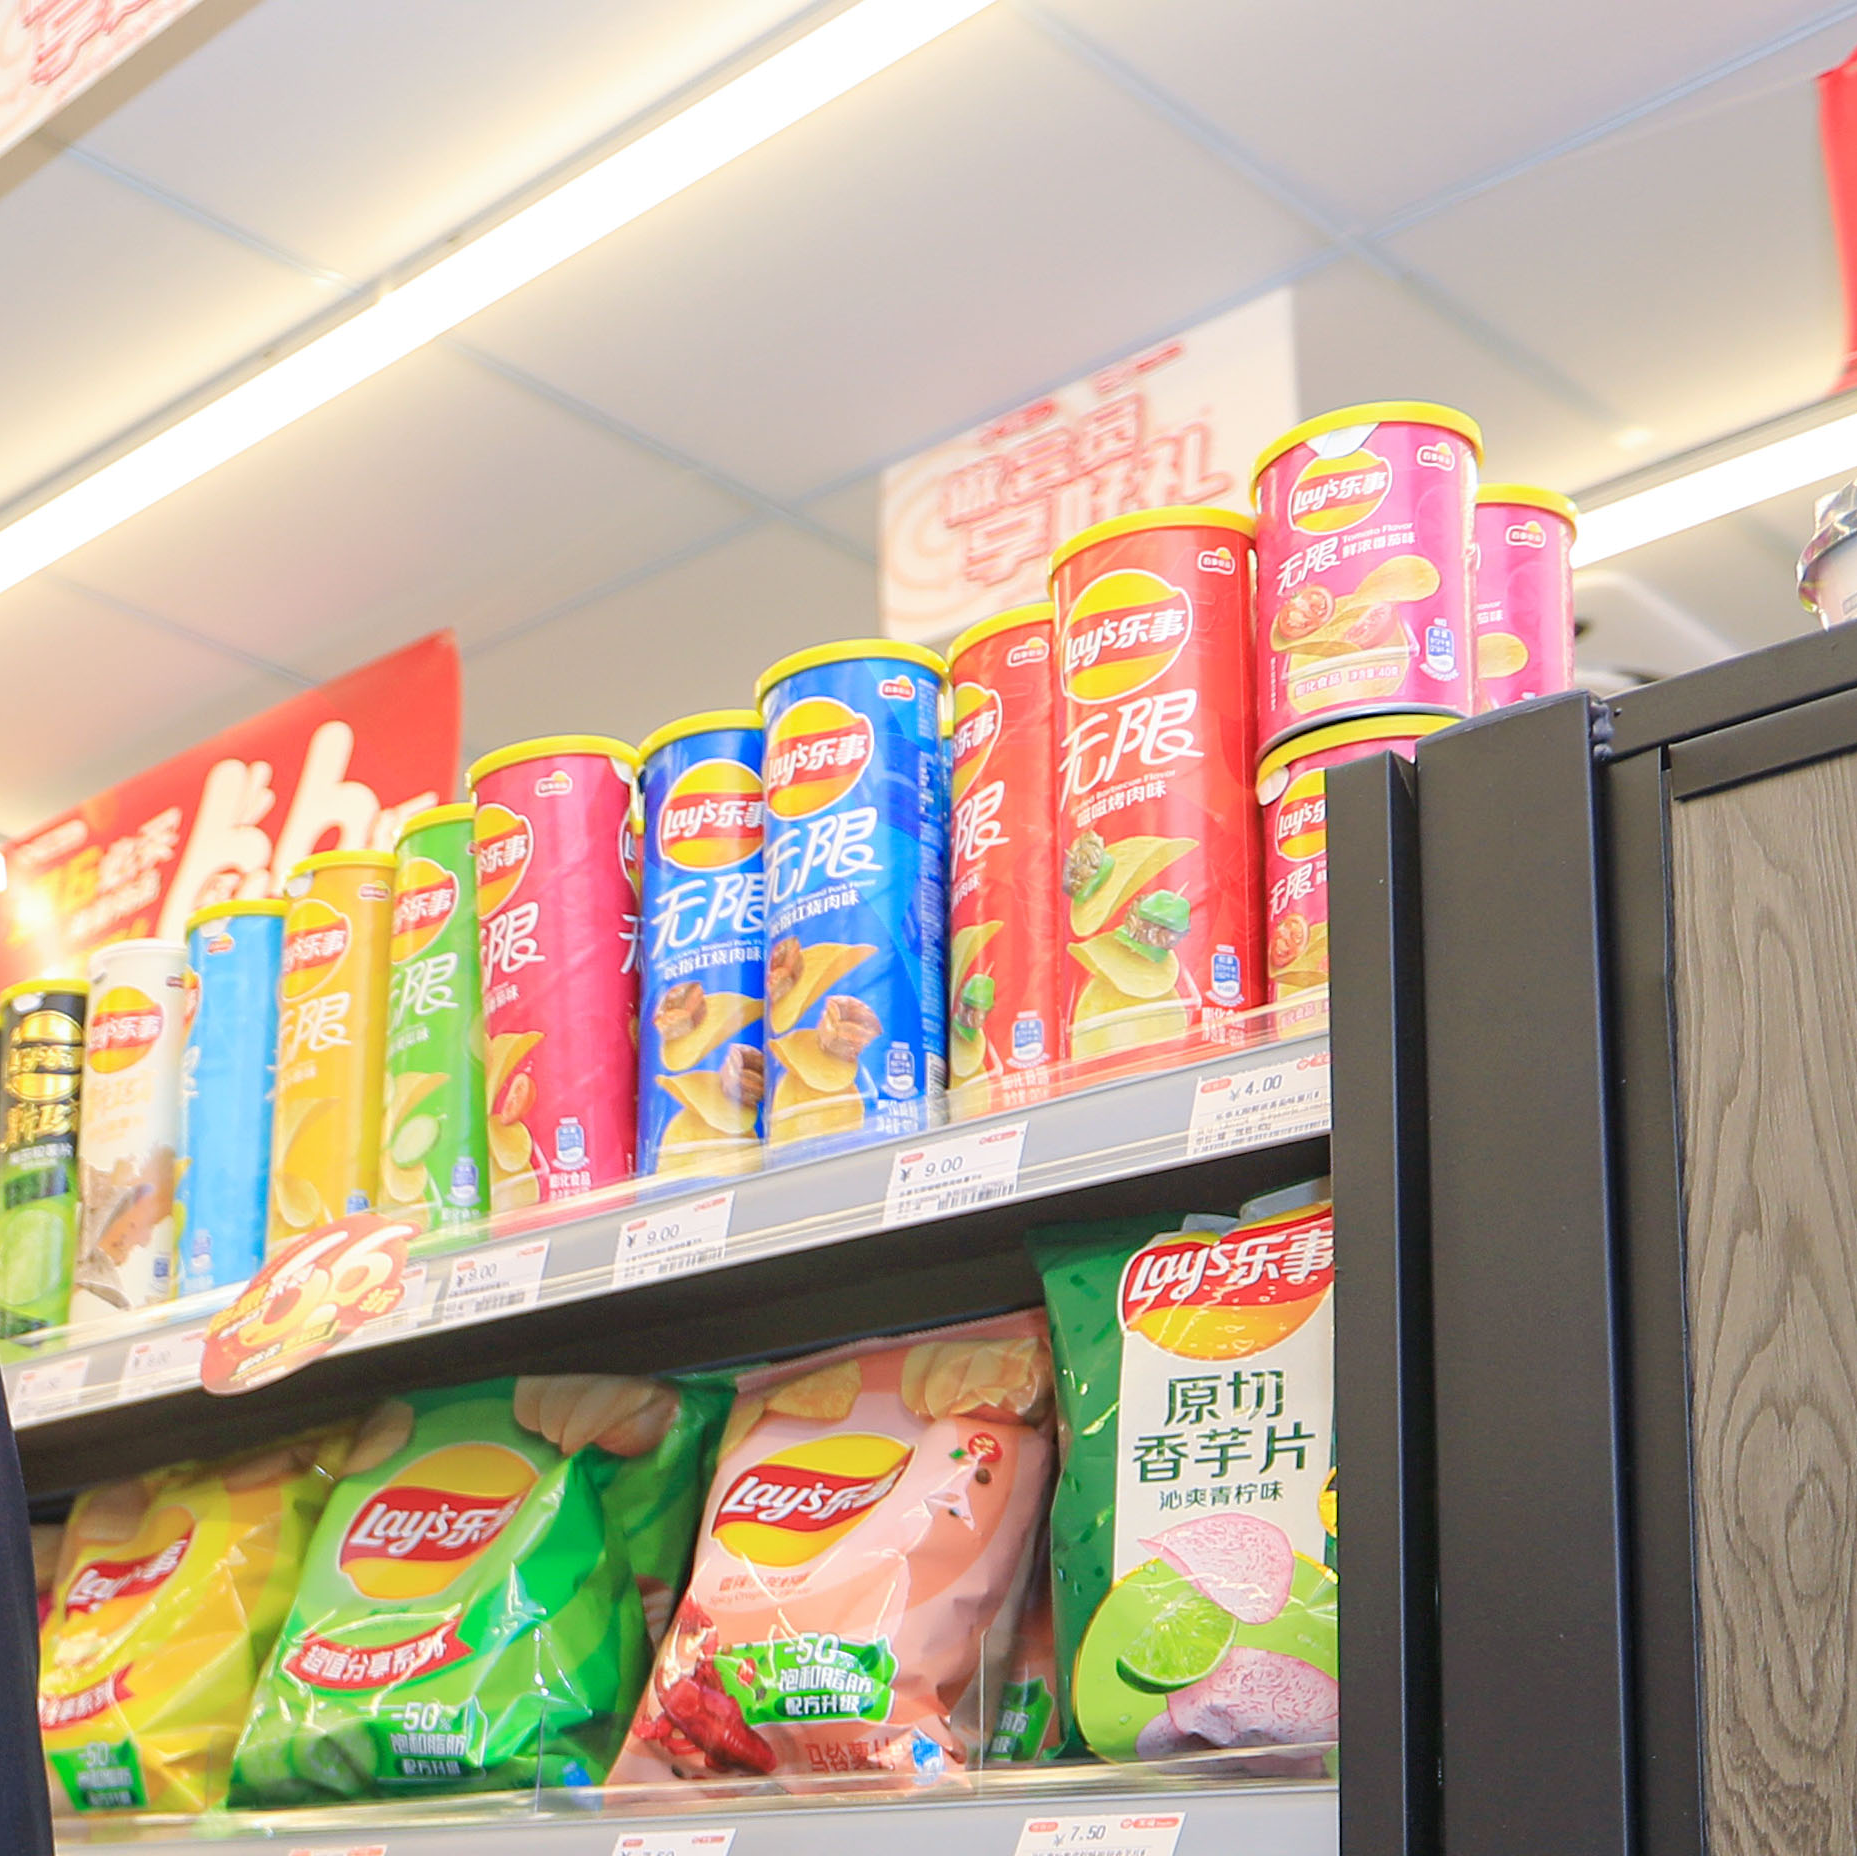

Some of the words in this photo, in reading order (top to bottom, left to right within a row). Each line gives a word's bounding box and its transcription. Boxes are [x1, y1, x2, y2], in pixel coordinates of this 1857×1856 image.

[1292, 471, 1388, 514] Lay's乐事
[1276, 536, 1341, 596] 无限
[1063, 608, 1187, 674] Lay's乐事
[1059, 689, 1204, 812] 无限
[766, 807, 882, 905] 无限
[1244, 1074, 1283, 1097] 4.00
[924, 1156, 964, 1178] 9.00
[646, 1224, 680, 1246] 9.00
[1128, 1228, 1334, 1302] Lay's乐事
[1164, 1370, 1285, 1427] 原切
[1133, 1422, 1316, 1483] 香芋片
[1159, 1481, 1284, 1511] 沁爽青柠味
[778, 1665, 875, 1694] 饱和脂肪
[1070, 1825, 1106, 1841] 7.50
